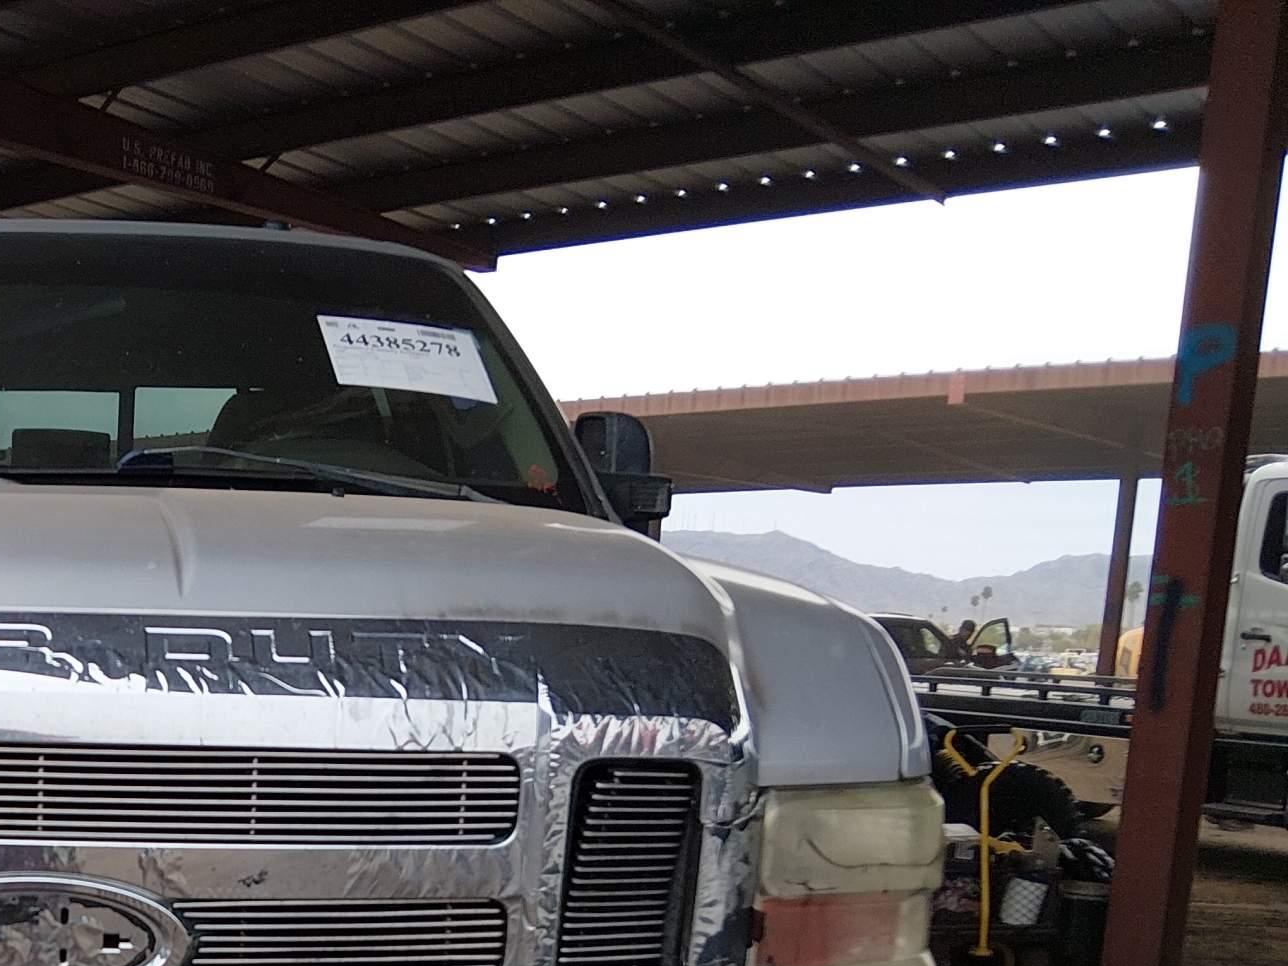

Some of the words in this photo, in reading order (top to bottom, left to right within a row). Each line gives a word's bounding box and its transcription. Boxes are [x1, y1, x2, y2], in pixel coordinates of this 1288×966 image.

[340, 333, 461, 358] 44385278
[1177, 324, 1238, 406] P
[143, 625, 526, 684] DUTY
[1252, 645, 1288, 673] DA
